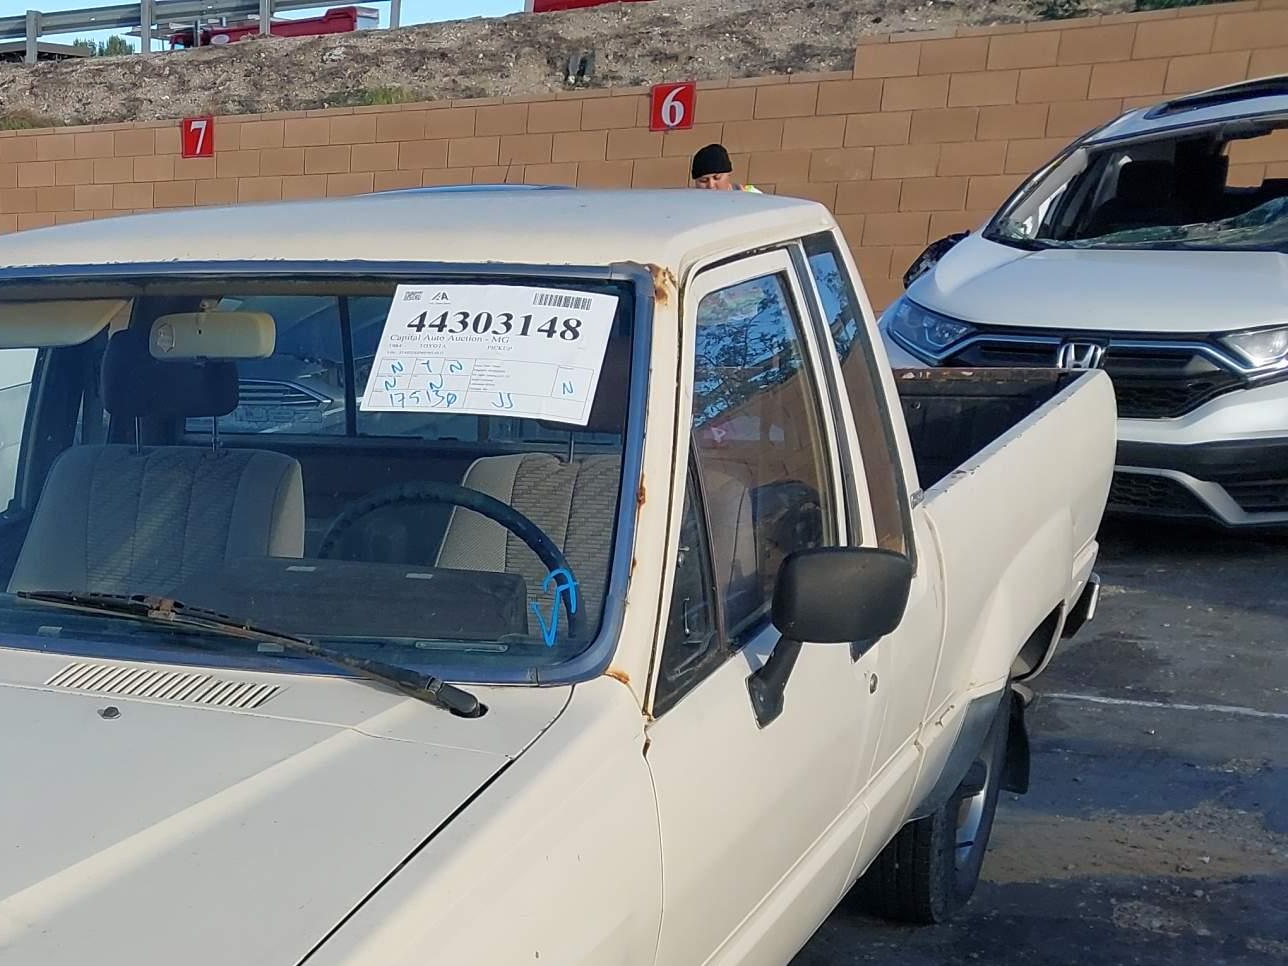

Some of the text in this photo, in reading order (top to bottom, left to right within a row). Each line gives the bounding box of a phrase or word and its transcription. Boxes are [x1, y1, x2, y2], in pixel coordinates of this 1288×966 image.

[662, 86, 686, 127] 6
[190, 120, 208, 155] 7
[389, 333, 421, 343] Capital
[423, 334, 445, 342] Auto
[447, 334, 483, 344] Auction
[491, 336, 510, 344] MG
[406, 310, 583, 341] 44303148
